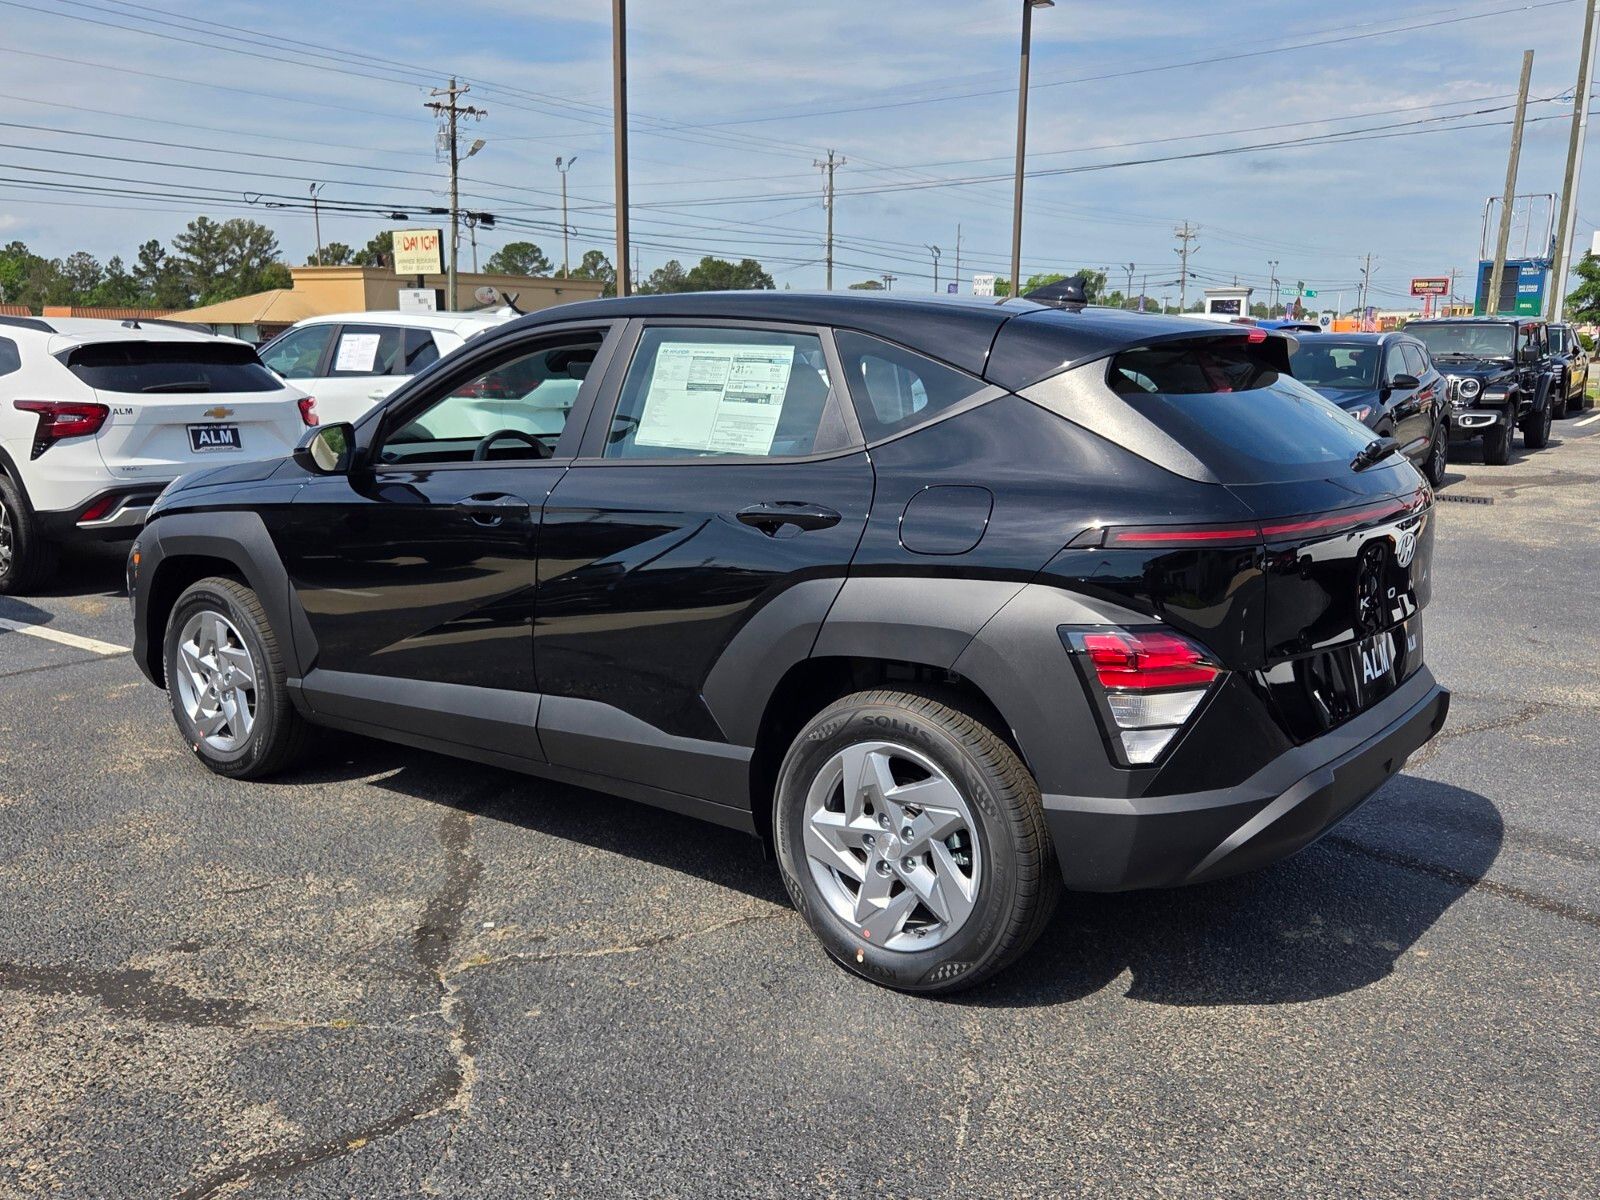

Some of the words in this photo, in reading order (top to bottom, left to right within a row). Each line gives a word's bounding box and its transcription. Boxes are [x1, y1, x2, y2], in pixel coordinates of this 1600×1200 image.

[112, 407, 134, 415] ALM
[199, 429, 233, 445] ALM
[1362, 640, 1390, 684] ALM
[862, 715, 932, 743] SOLUS
